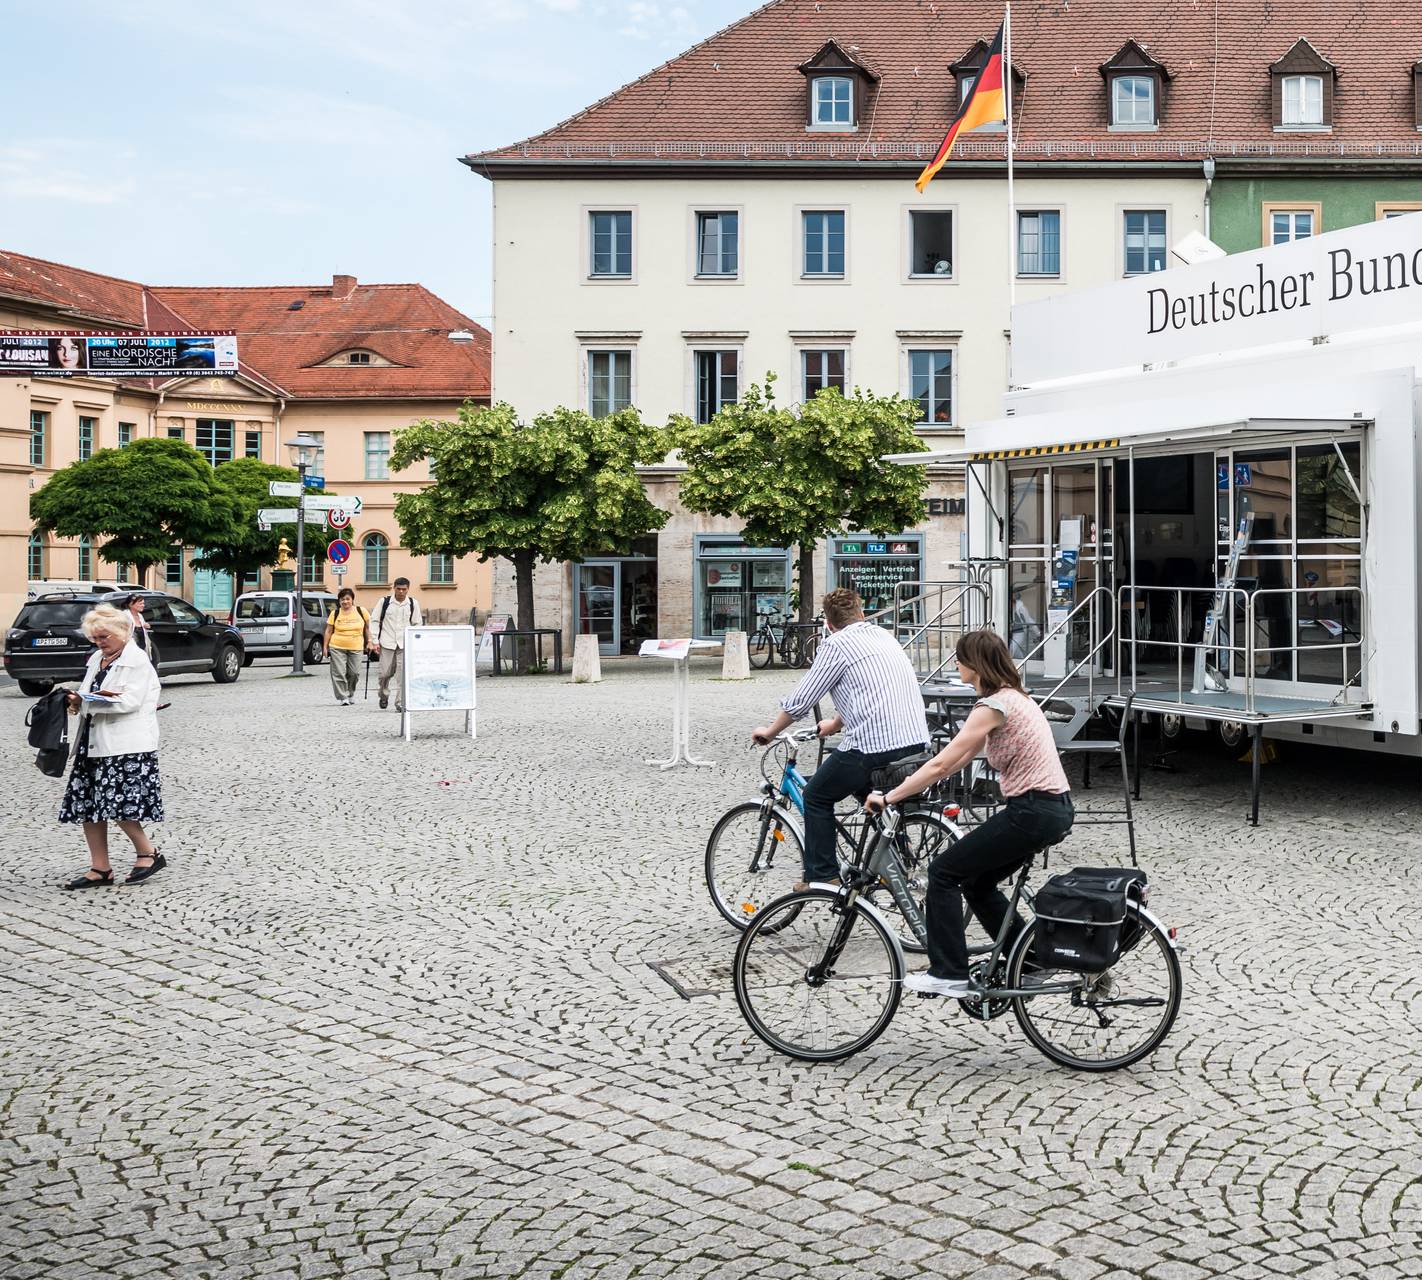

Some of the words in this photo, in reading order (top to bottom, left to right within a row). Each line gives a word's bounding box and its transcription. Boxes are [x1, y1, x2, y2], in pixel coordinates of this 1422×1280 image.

[1146, 263, 1315, 335] Deutscher
[92, 350, 110, 358] EINE
[112, 348, 177, 358] NORDISCHE
[138, 357, 177, 367] NACHT
[869, 544, 885, 552] TLZ
[840, 566, 876, 574] Anzeigen
[883, 565, 916, 573] Vertrieb
[851, 573, 904, 581] Leserservice
[885, 861, 928, 937] VICTORIA
